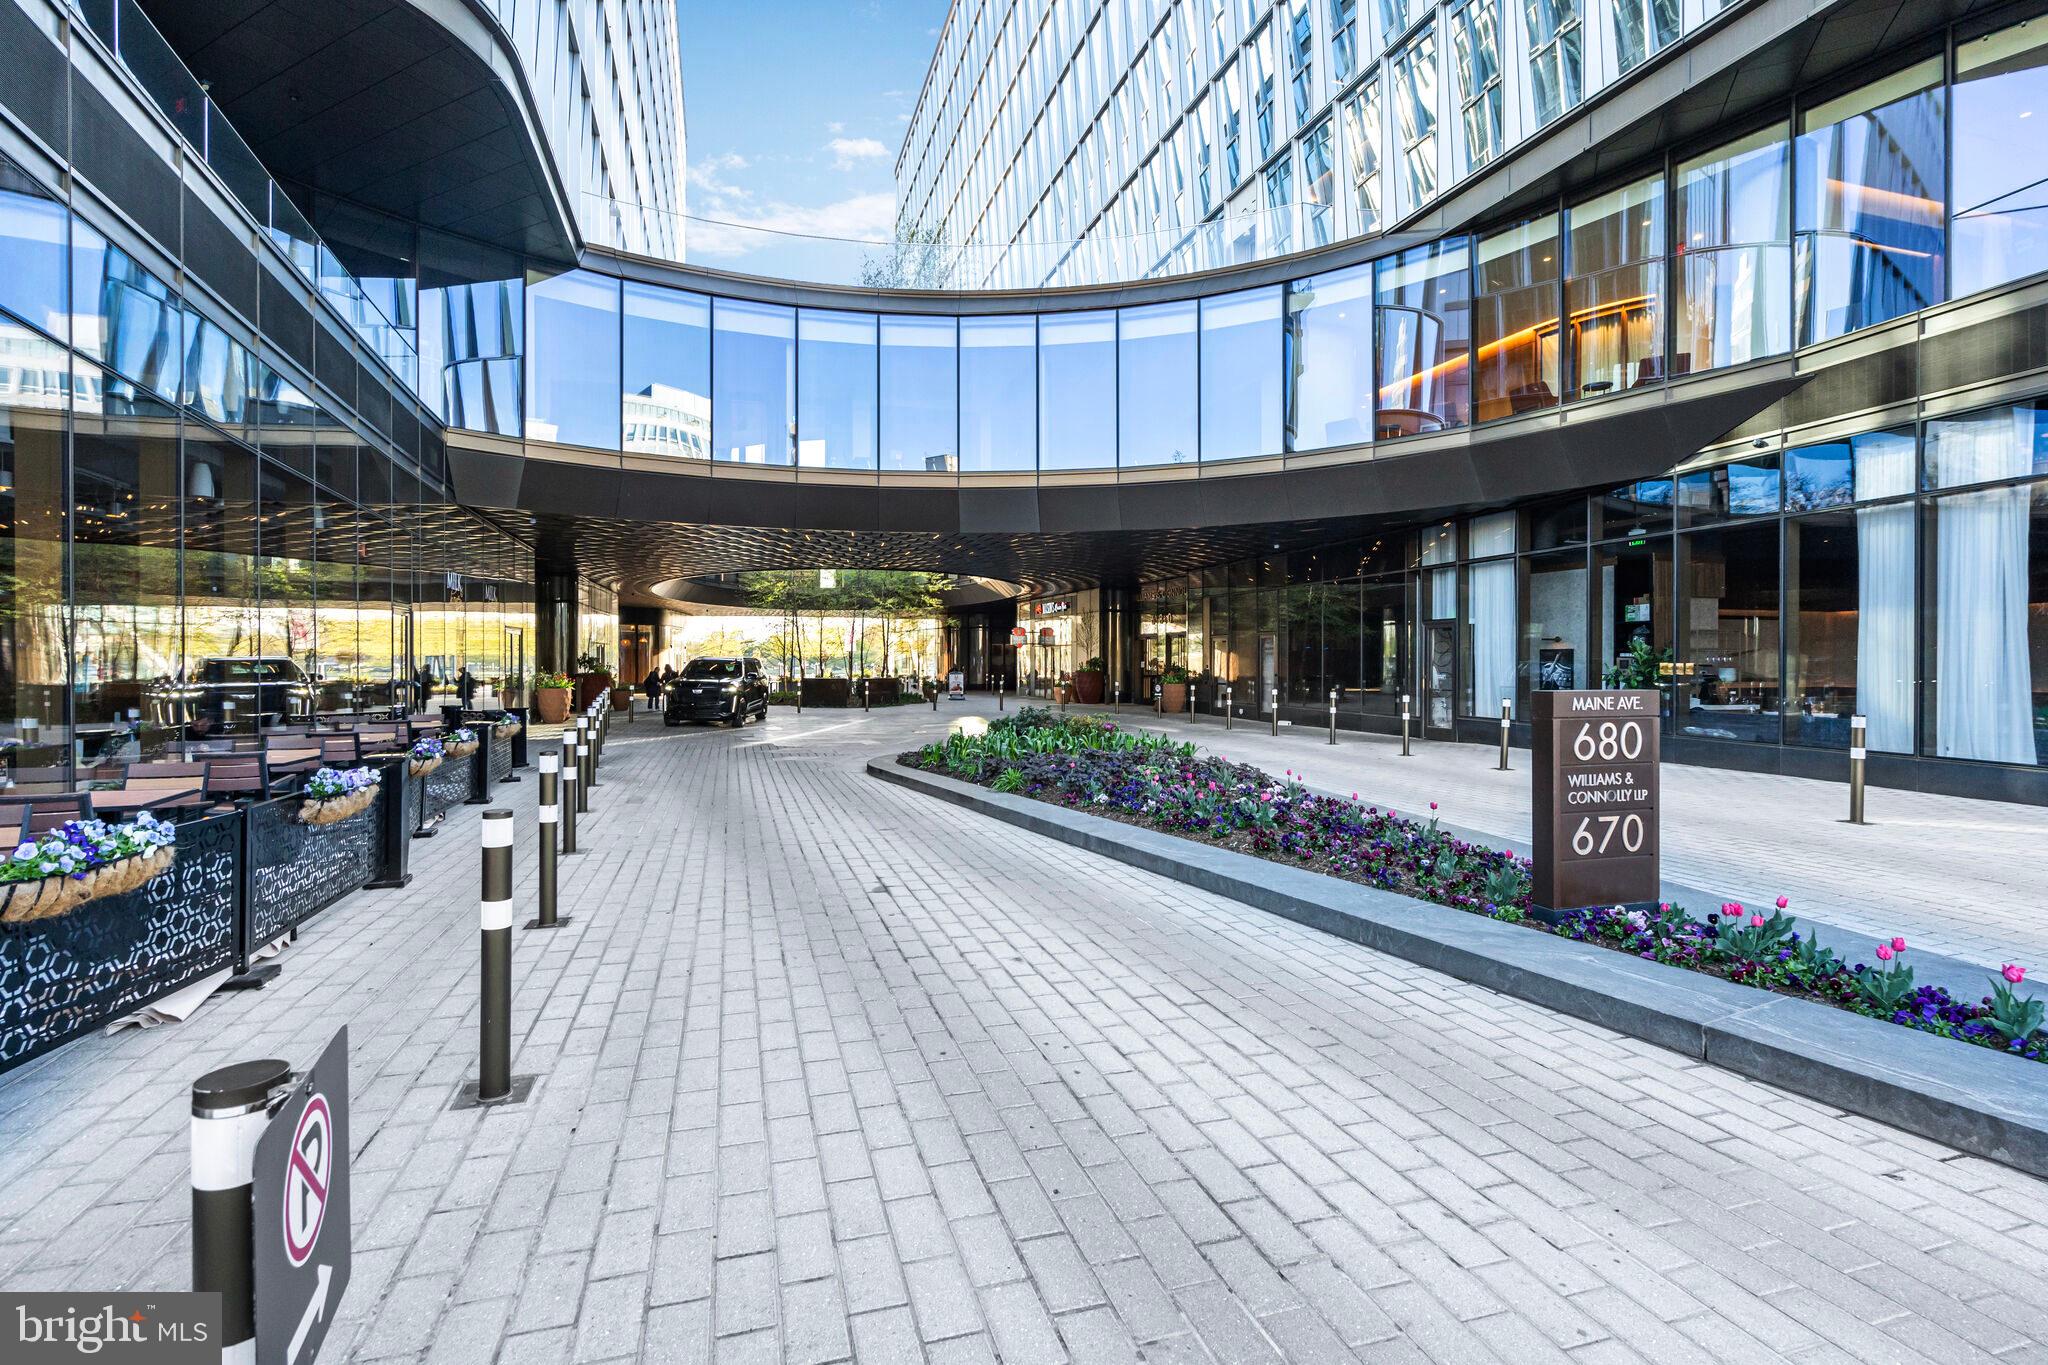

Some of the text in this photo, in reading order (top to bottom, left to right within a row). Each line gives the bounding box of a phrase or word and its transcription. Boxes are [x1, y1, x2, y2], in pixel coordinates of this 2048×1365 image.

[1572, 696, 1643, 711] MAINE AVE.
[1573, 721, 1643, 761] 680
[1567, 772, 1634, 788] WILLIAMS &
[1567, 789, 1649, 804] CONNOLLY LLP
[1572, 814, 1644, 856] 670
